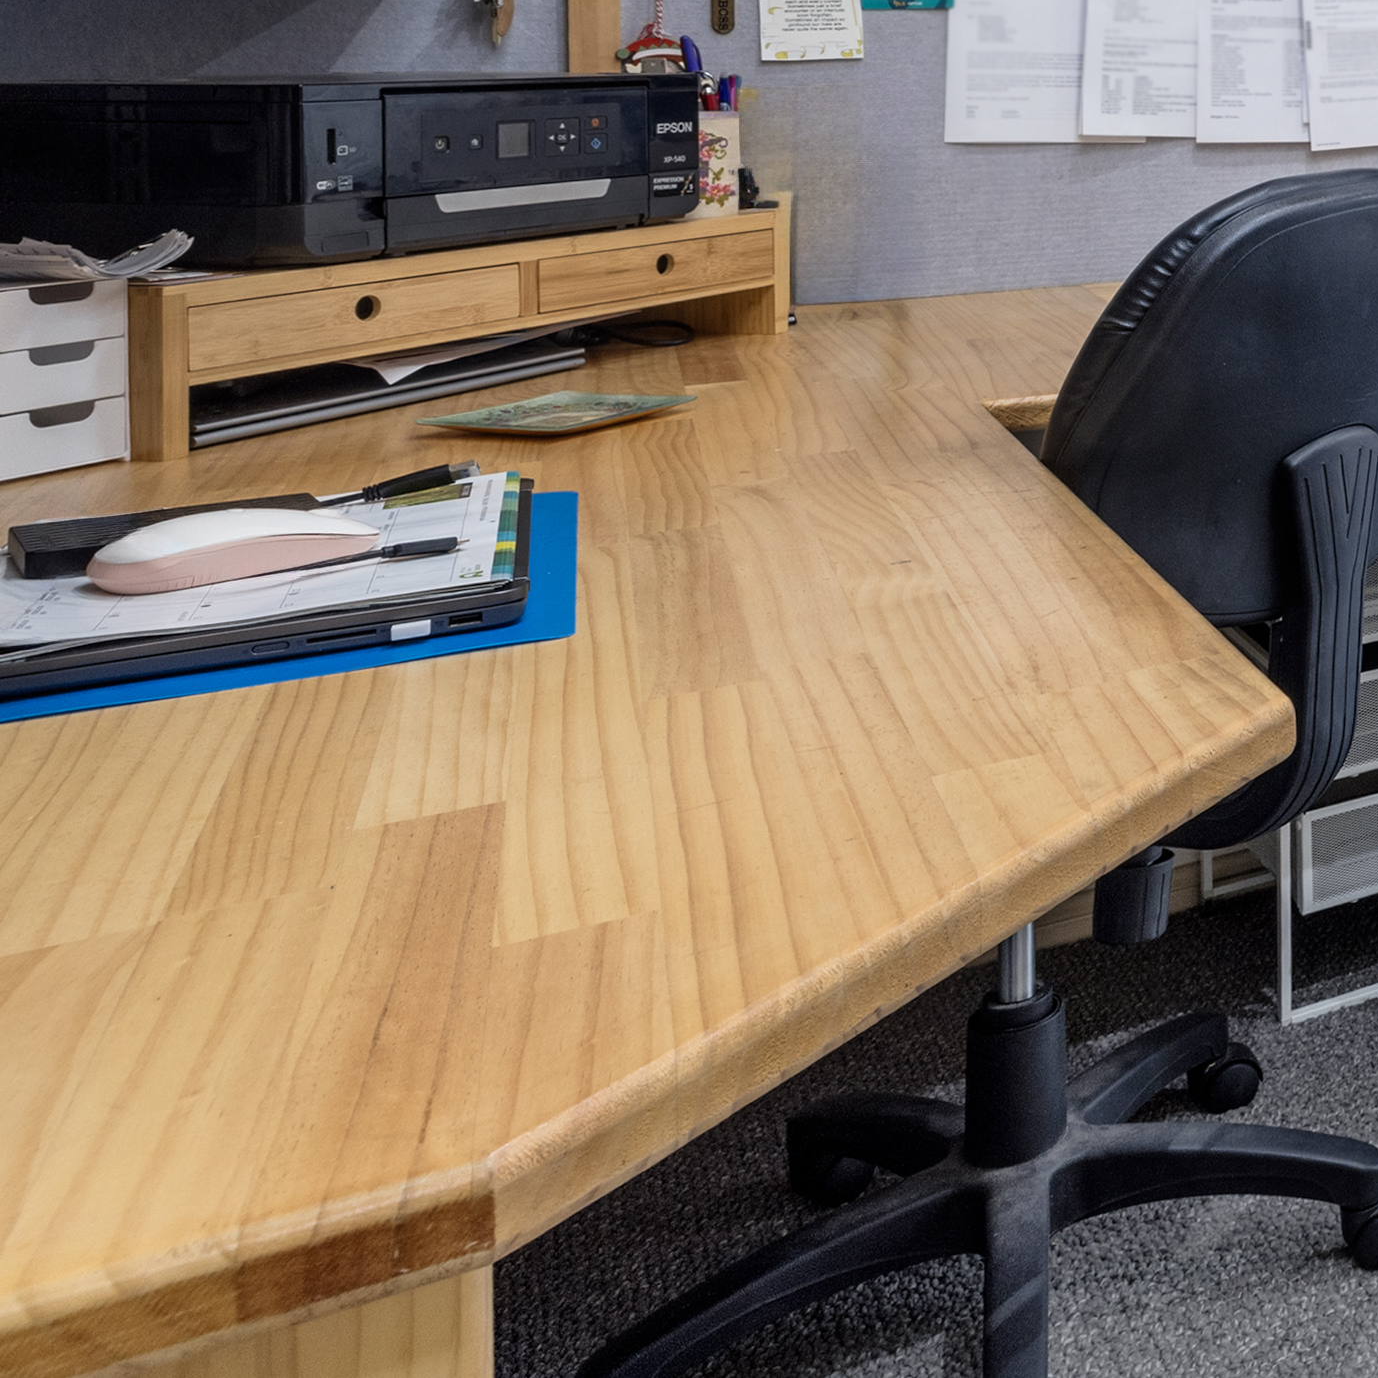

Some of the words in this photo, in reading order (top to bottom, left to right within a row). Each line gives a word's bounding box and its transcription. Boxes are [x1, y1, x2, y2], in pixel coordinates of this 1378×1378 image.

[718, 0, 728, 30] BOSS
[656, 122, 693, 134] EPSON
[663, 155, 686, 163] XP-540
